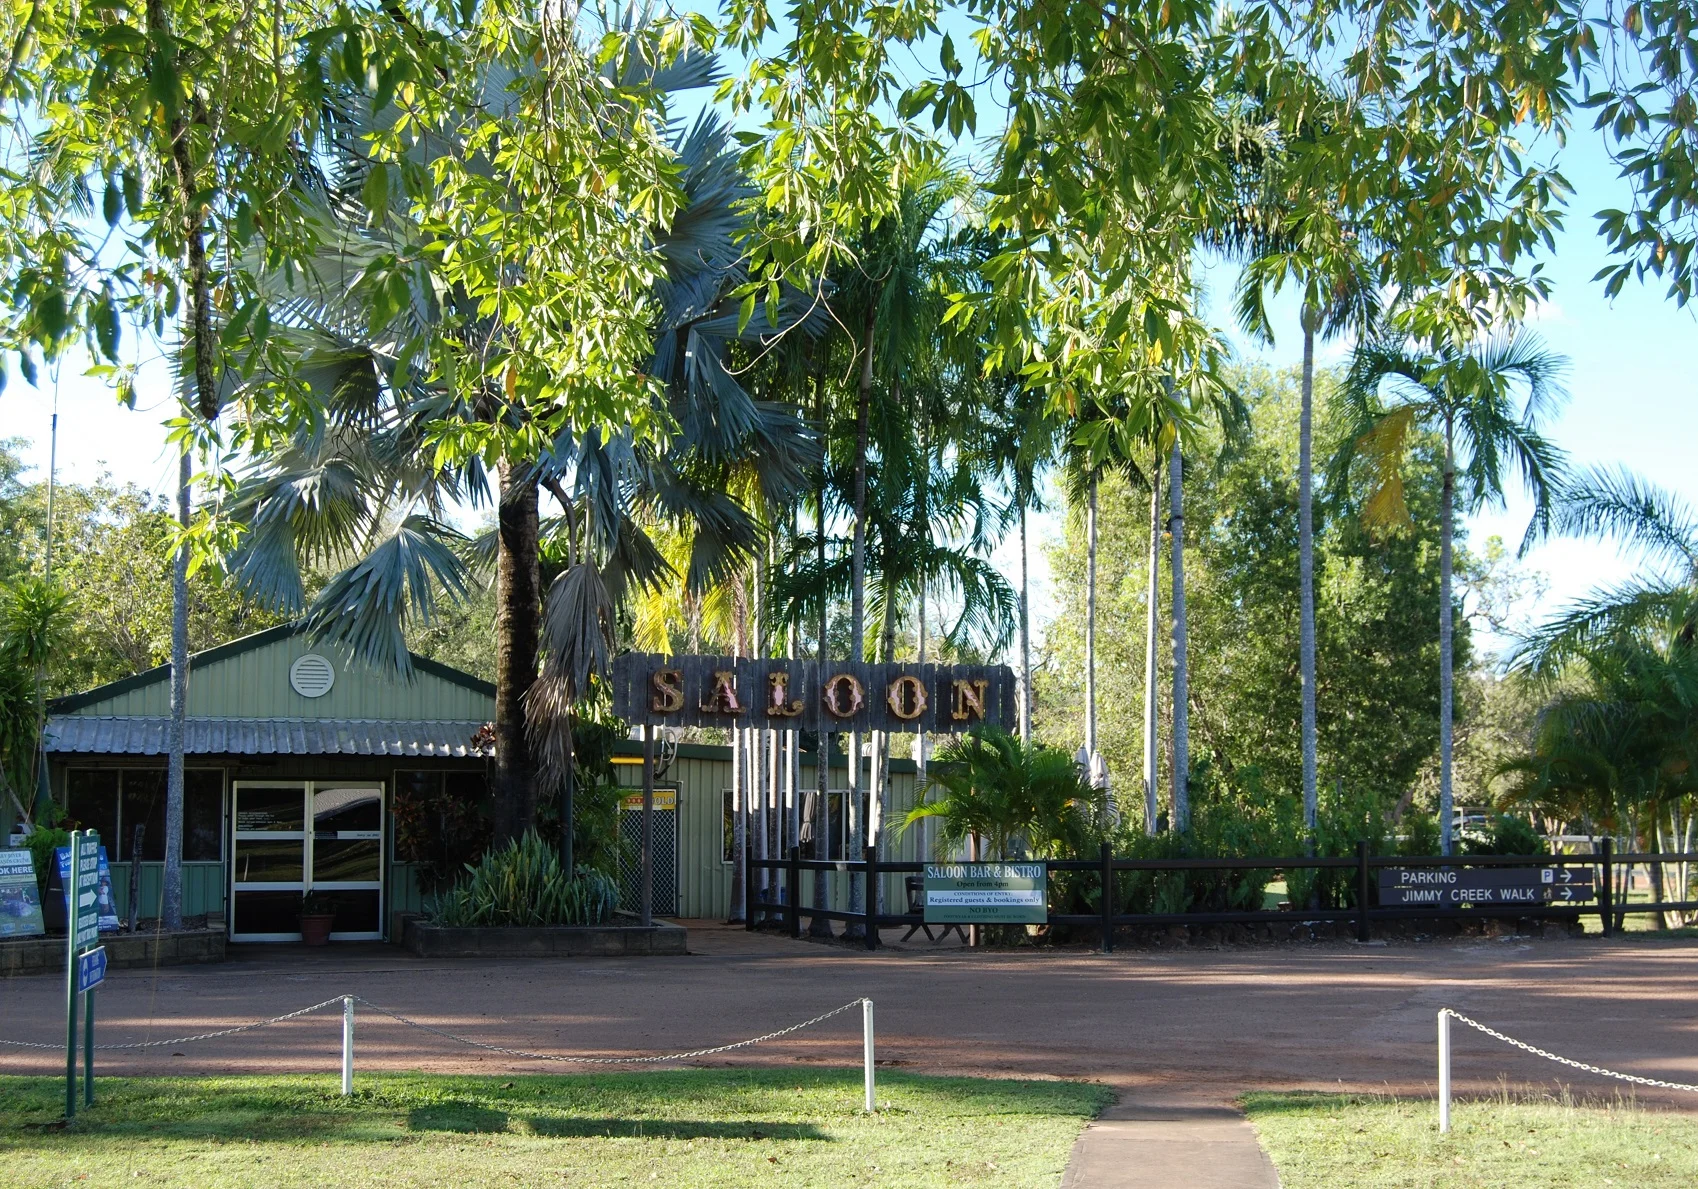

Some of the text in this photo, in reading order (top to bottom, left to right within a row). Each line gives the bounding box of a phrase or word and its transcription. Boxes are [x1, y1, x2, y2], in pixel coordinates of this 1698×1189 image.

[651, 668, 990, 720] SALOON
[11, 866, 33, 874] HERE
[927, 865, 1041, 879] SALOON BAR & BISTRO
[1401, 872, 1457, 884] PARKING
[1402, 888, 1535, 902] JIMMY CREEK WALK
